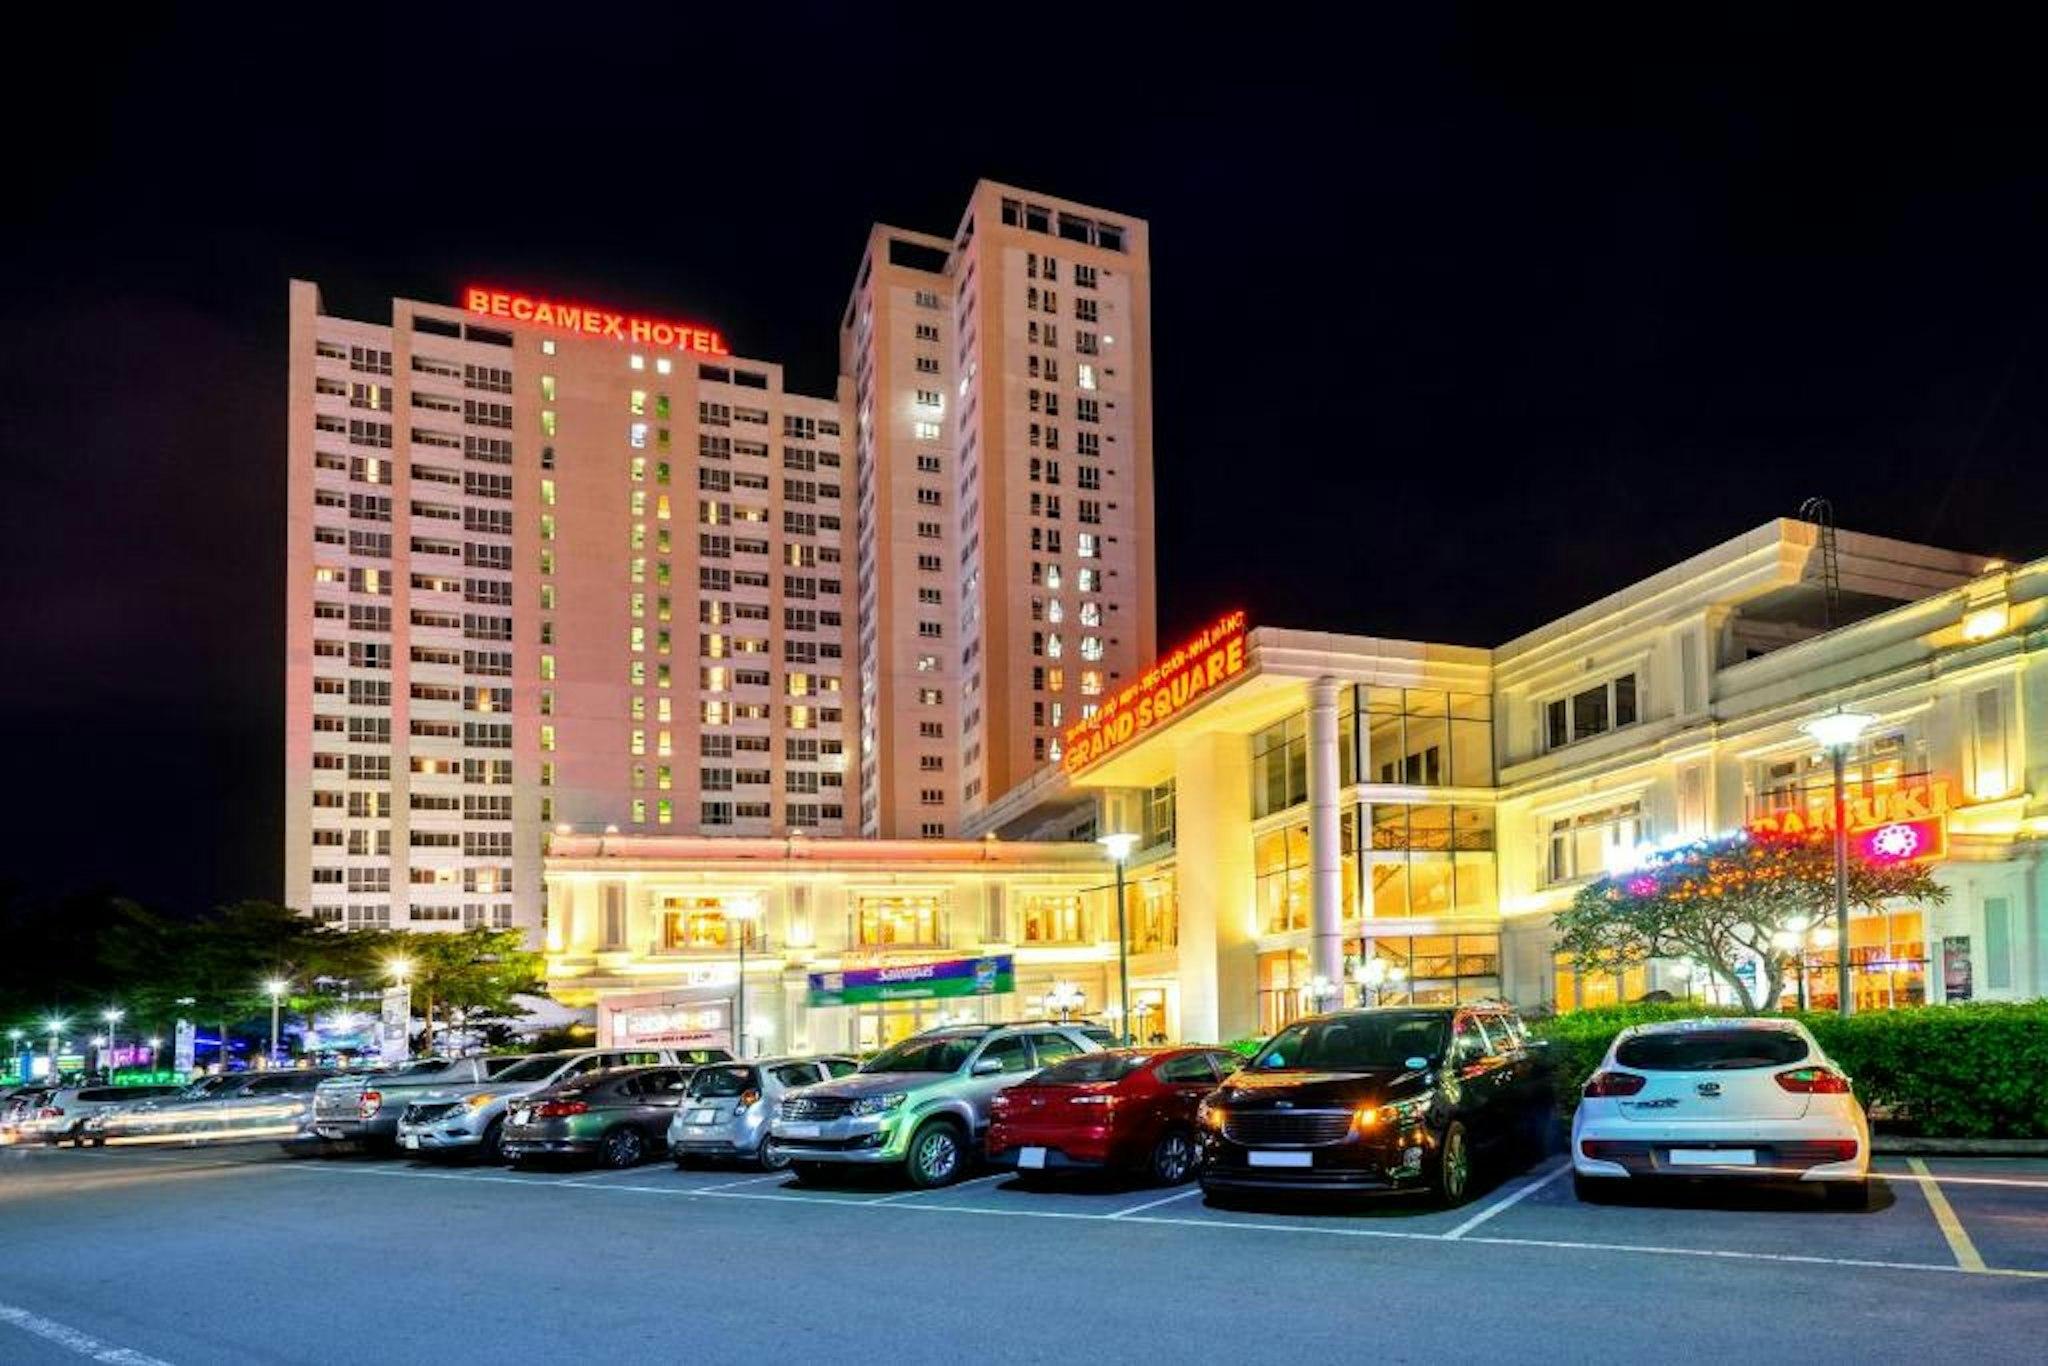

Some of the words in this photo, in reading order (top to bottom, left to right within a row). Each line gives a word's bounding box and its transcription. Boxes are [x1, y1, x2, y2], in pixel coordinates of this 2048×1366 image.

[468, 288, 624, 340] BECAMEX
[630, 319, 729, 355] HOTEL
[1065, 711, 1135, 771] GRAND
[1138, 637, 1244, 728] SQUARE
